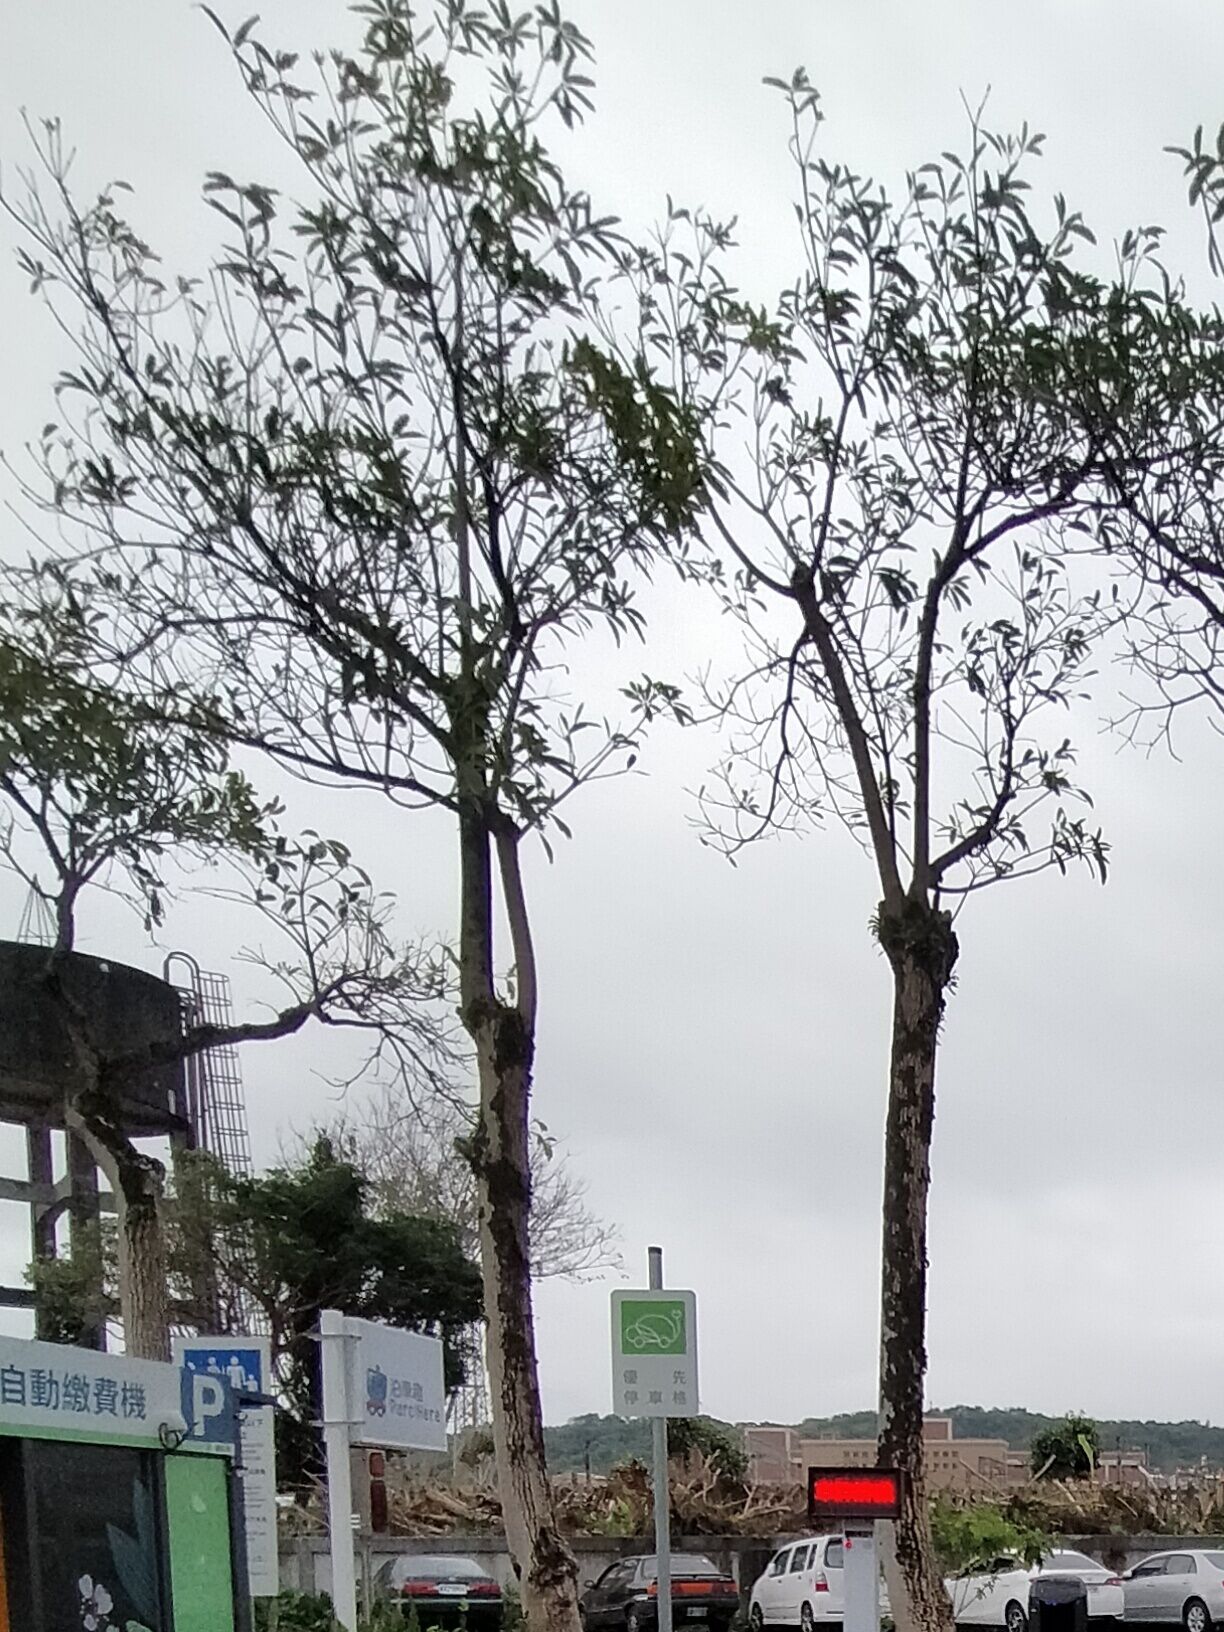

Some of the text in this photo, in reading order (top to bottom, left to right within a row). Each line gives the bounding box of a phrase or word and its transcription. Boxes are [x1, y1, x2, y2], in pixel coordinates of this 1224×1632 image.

[0, 1364, 147, 1421] 自動繳費機
[192, 1373, 226, 1437] P
